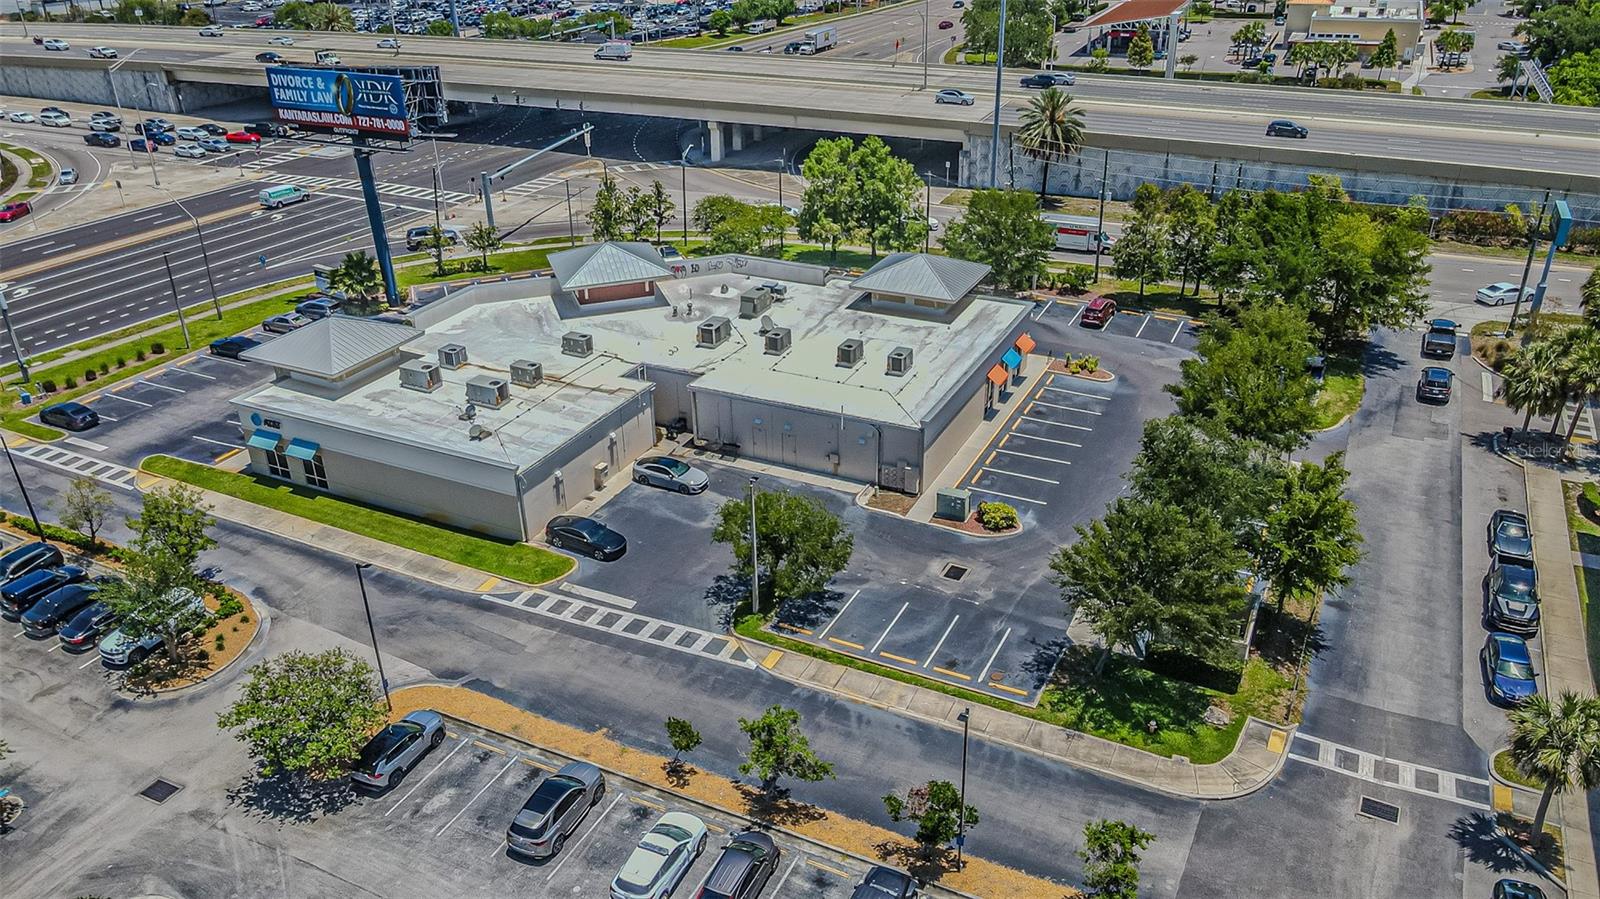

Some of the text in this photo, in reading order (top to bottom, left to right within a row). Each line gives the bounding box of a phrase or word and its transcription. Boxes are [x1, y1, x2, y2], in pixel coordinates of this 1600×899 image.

[270, 73, 325, 90] DIVORCE &
[273, 87, 308, 102] FAMILY
[310, 91, 334, 104] LAW
